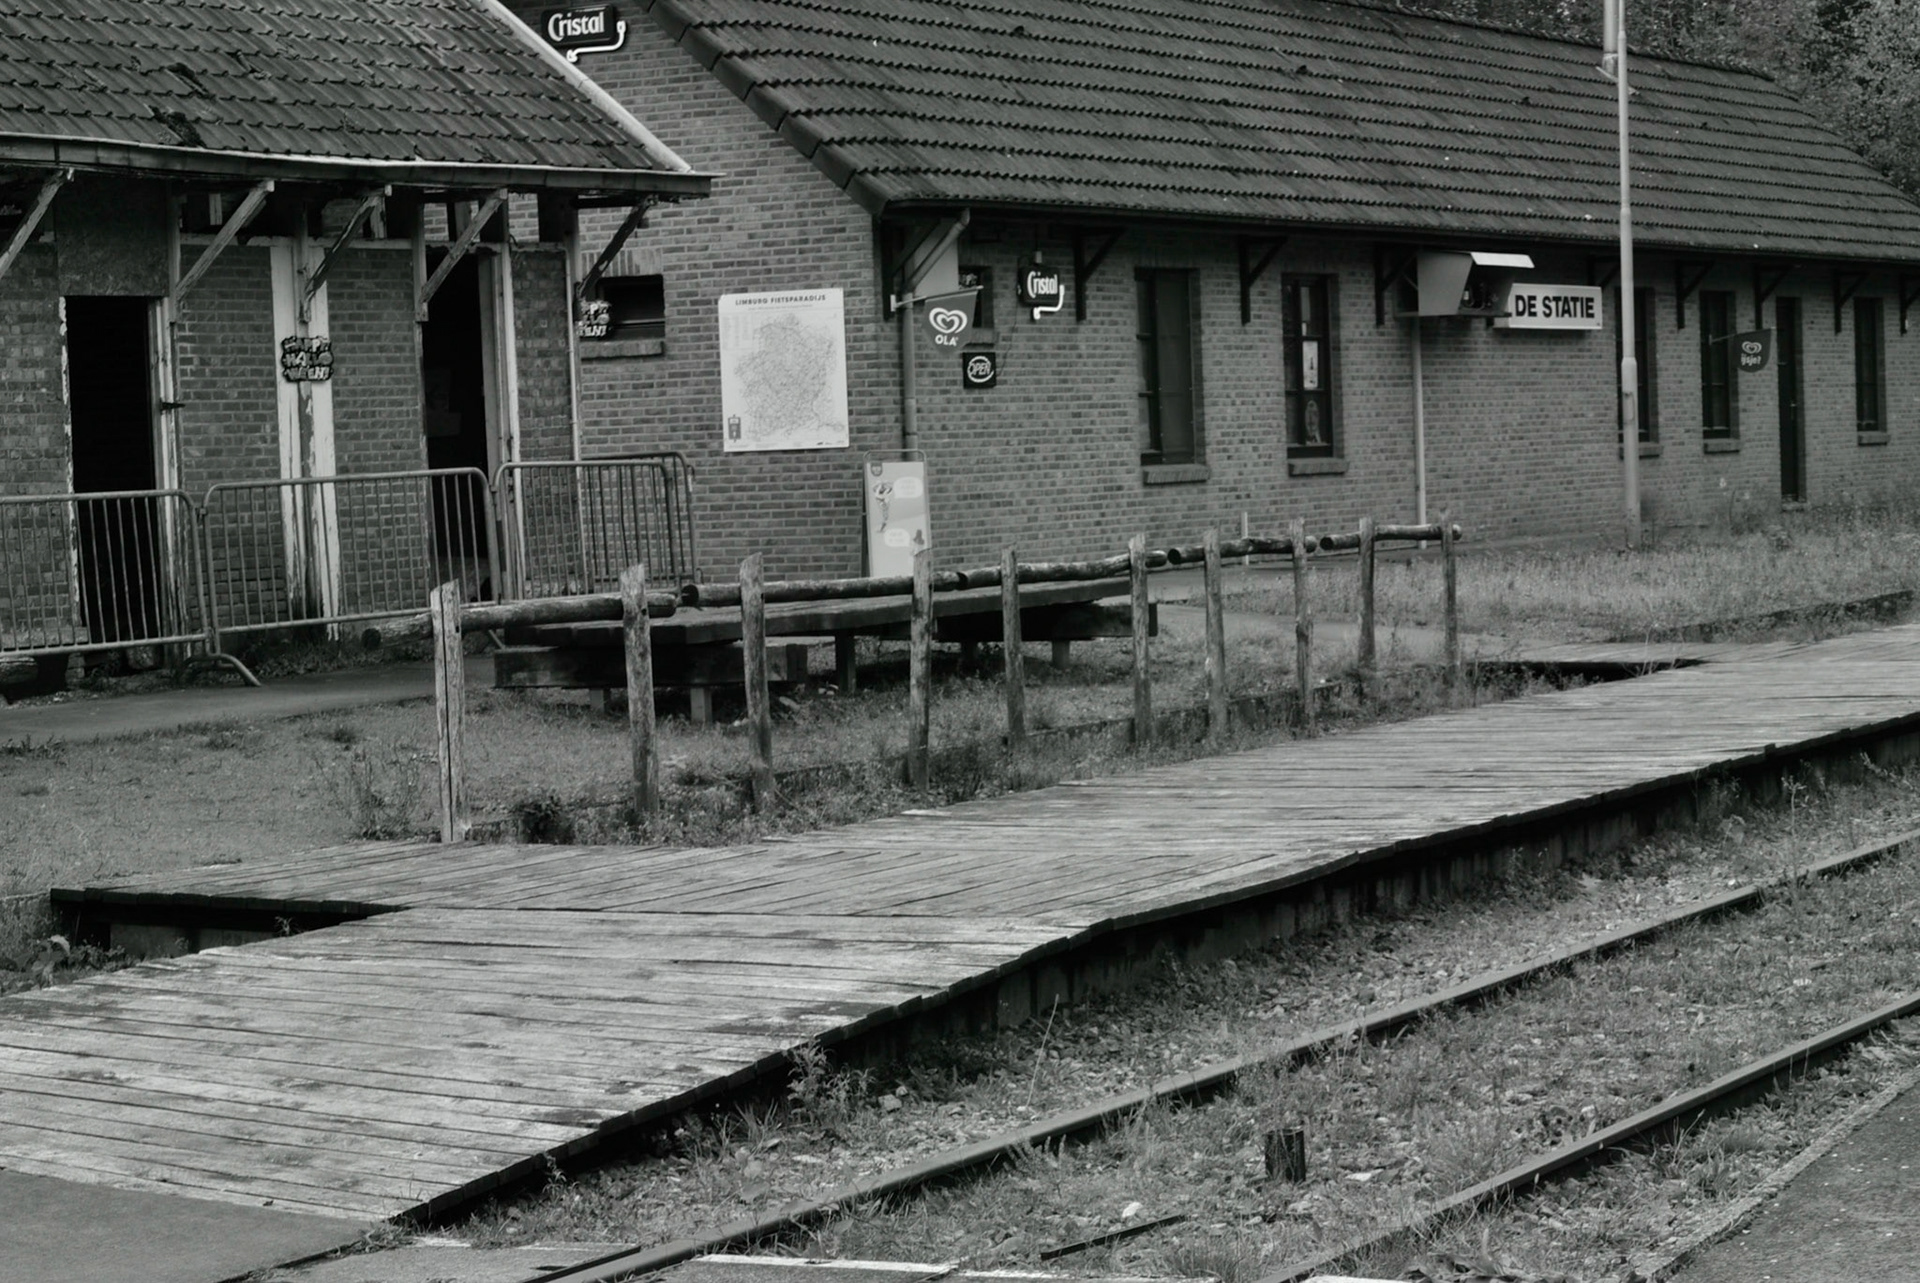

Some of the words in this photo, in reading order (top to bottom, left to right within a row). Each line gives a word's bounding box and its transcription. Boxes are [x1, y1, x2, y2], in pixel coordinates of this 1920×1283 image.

[547, 11, 605, 42] Cristal
[1027, 270, 1058, 299] Cristal
[735, 298, 768, 306] LIMBURG
[770, 294, 826, 304] FIETSPARADIJS
[1515, 294, 1538, 317] DE
[1541, 295, 1595, 319] STATIE
[934, 334, 957, 347] OLA
[968, 361, 992, 376] OPEN
